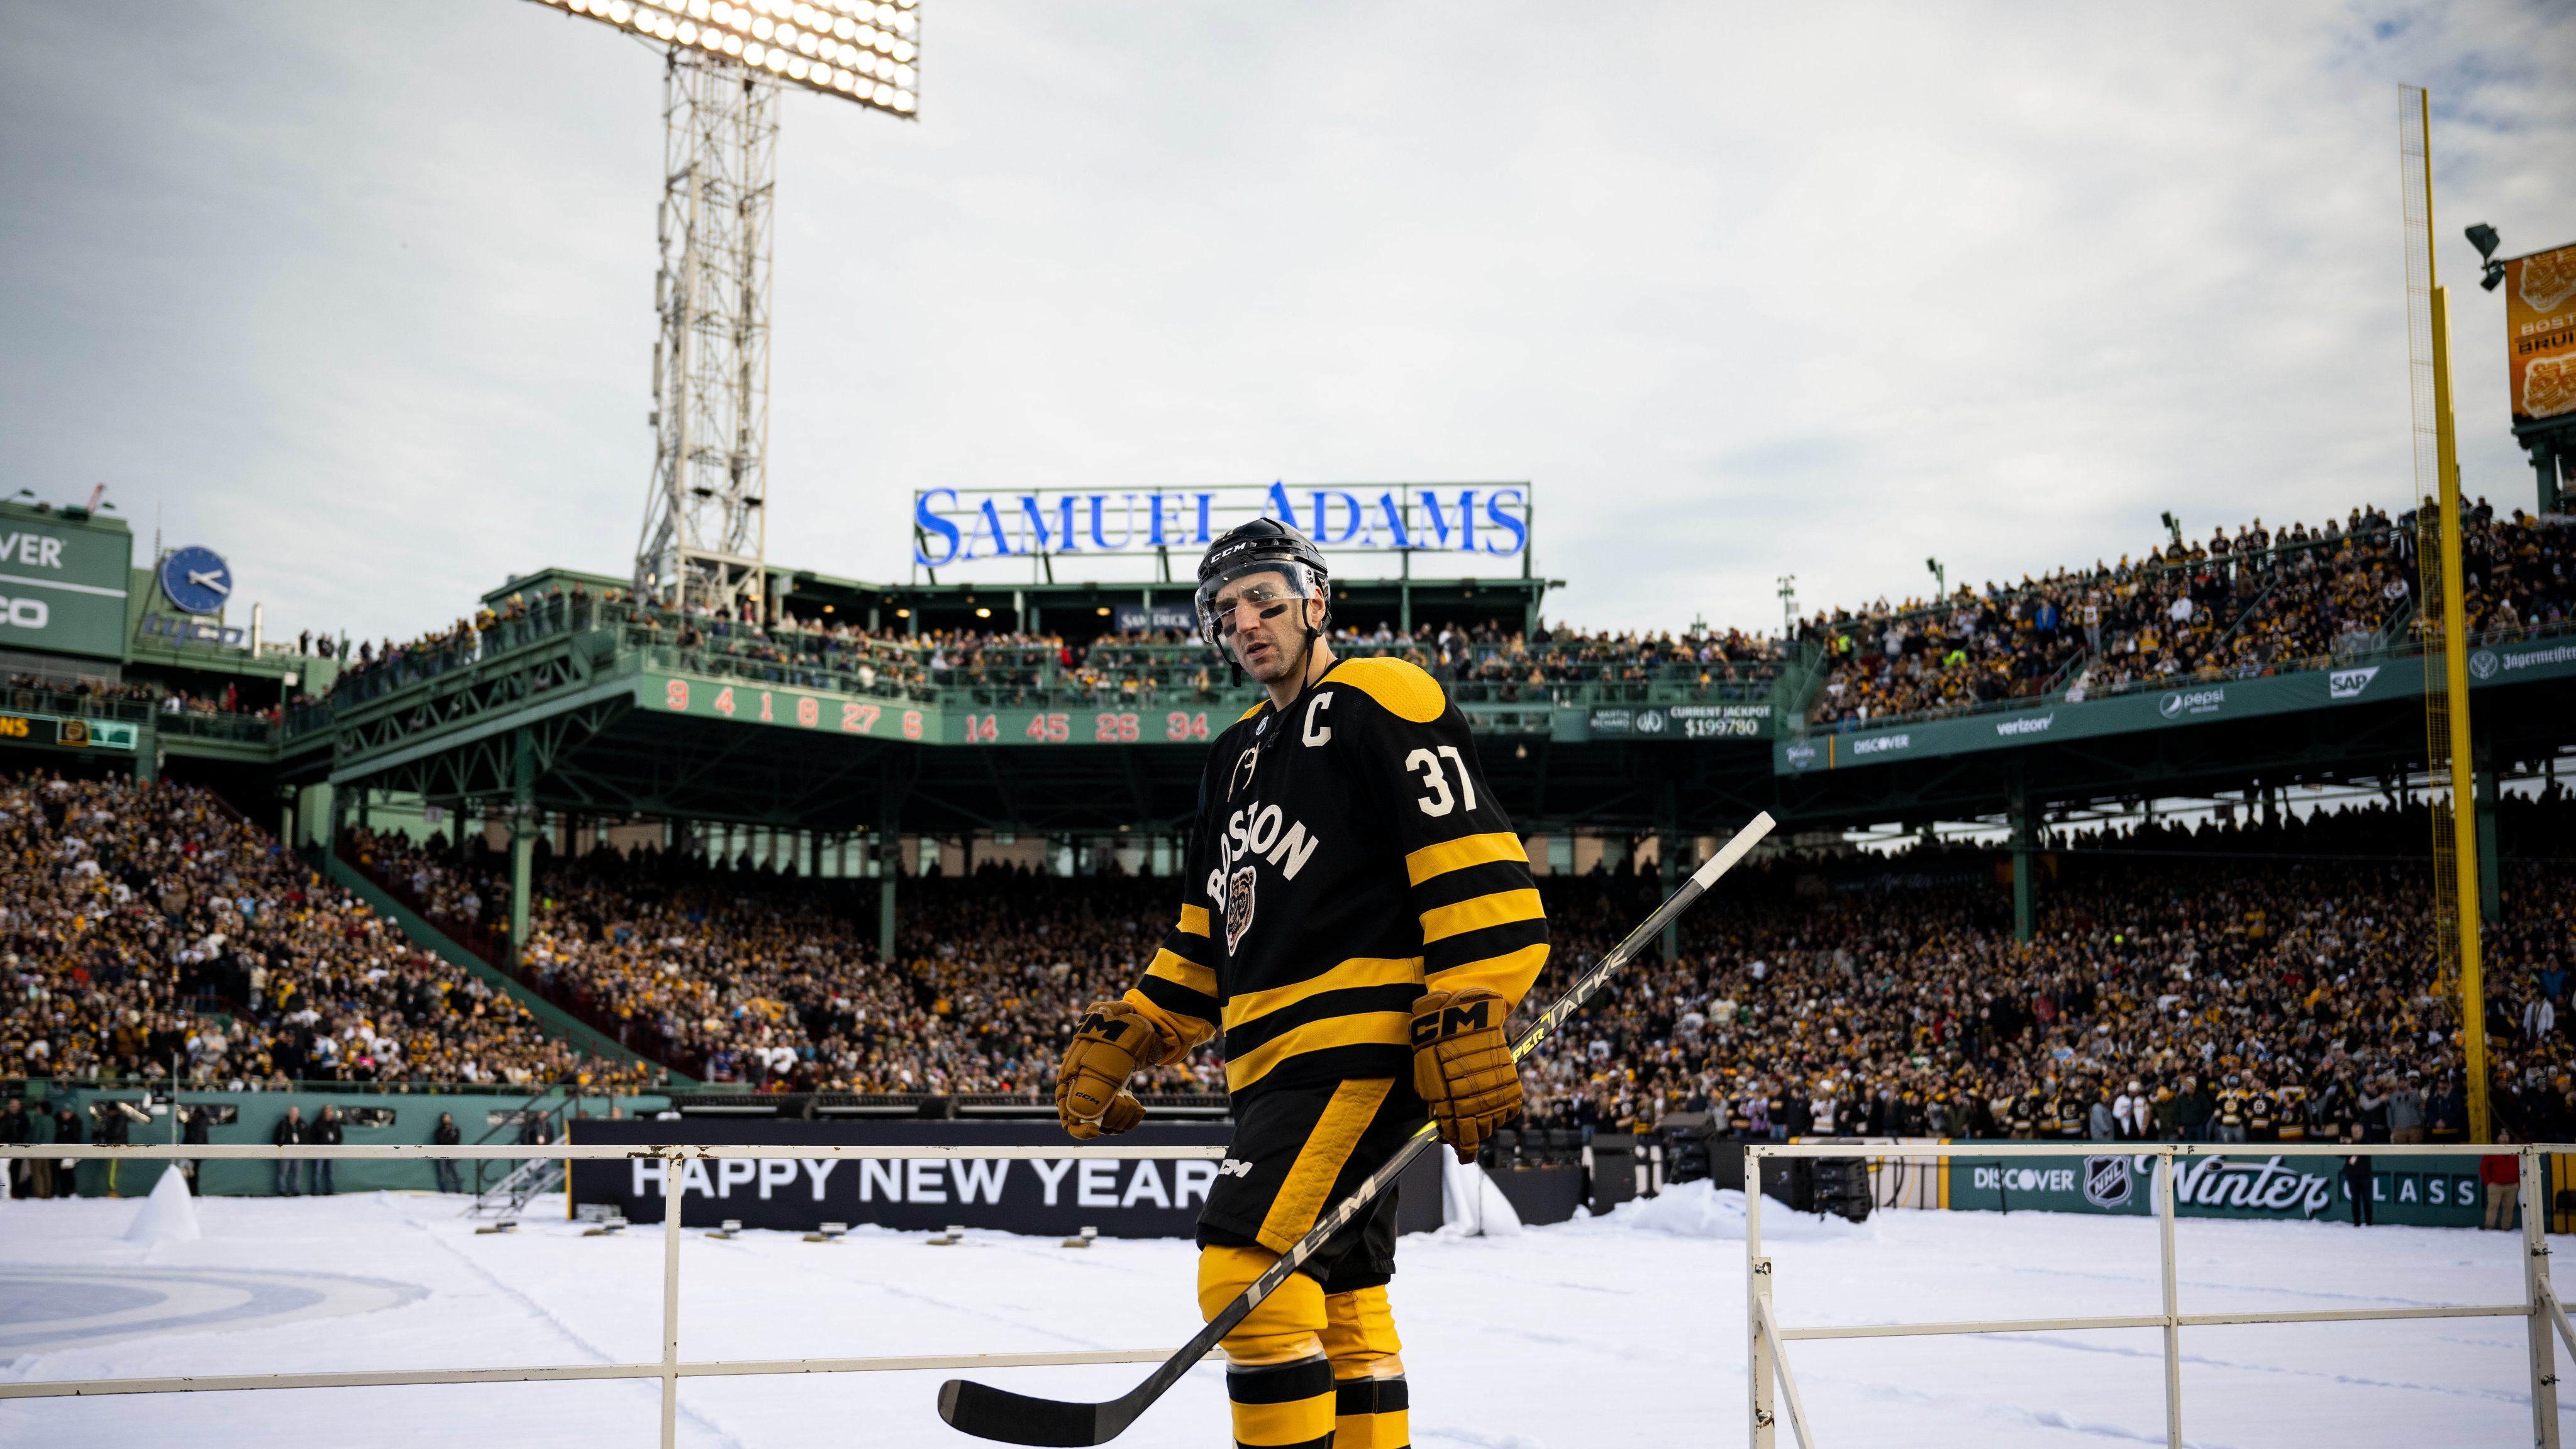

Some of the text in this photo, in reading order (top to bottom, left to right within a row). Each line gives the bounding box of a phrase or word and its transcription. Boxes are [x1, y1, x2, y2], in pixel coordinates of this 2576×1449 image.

[914, 479, 1528, 567] SAMUEL ADAMS
[1211, 542, 1246, 564] CCM
[2184, 687, 2224, 709] pepsi
[2333, 675, 2367, 691] SAP
[667, 679, 923, 740] 9 4 1 8 27 6
[966, 711, 1210, 743] 14 45 26 34
[1302, 692, 1334, 747] C
[1670, 705, 1771, 718] CURRENT JACKPOT
[1997, 716, 2051, 735] verizon
[1854, 734, 1909, 754] DISCOVER
[1405, 746, 1477, 818] 37
[1207, 801, 1319, 914] BOSTON
[1075, 1092, 1100, 1105] CCM
[632, 1158, 840, 1201] HAPPY
[860, 1158, 1011, 1204] NEW
[1974, 1167, 2075, 1192] DISCOVER
[2094, 1164, 2122, 1194] NHL
[2134, 1155, 2329, 1218] Winter
[1247, 1174, 1376, 1310] CCM
